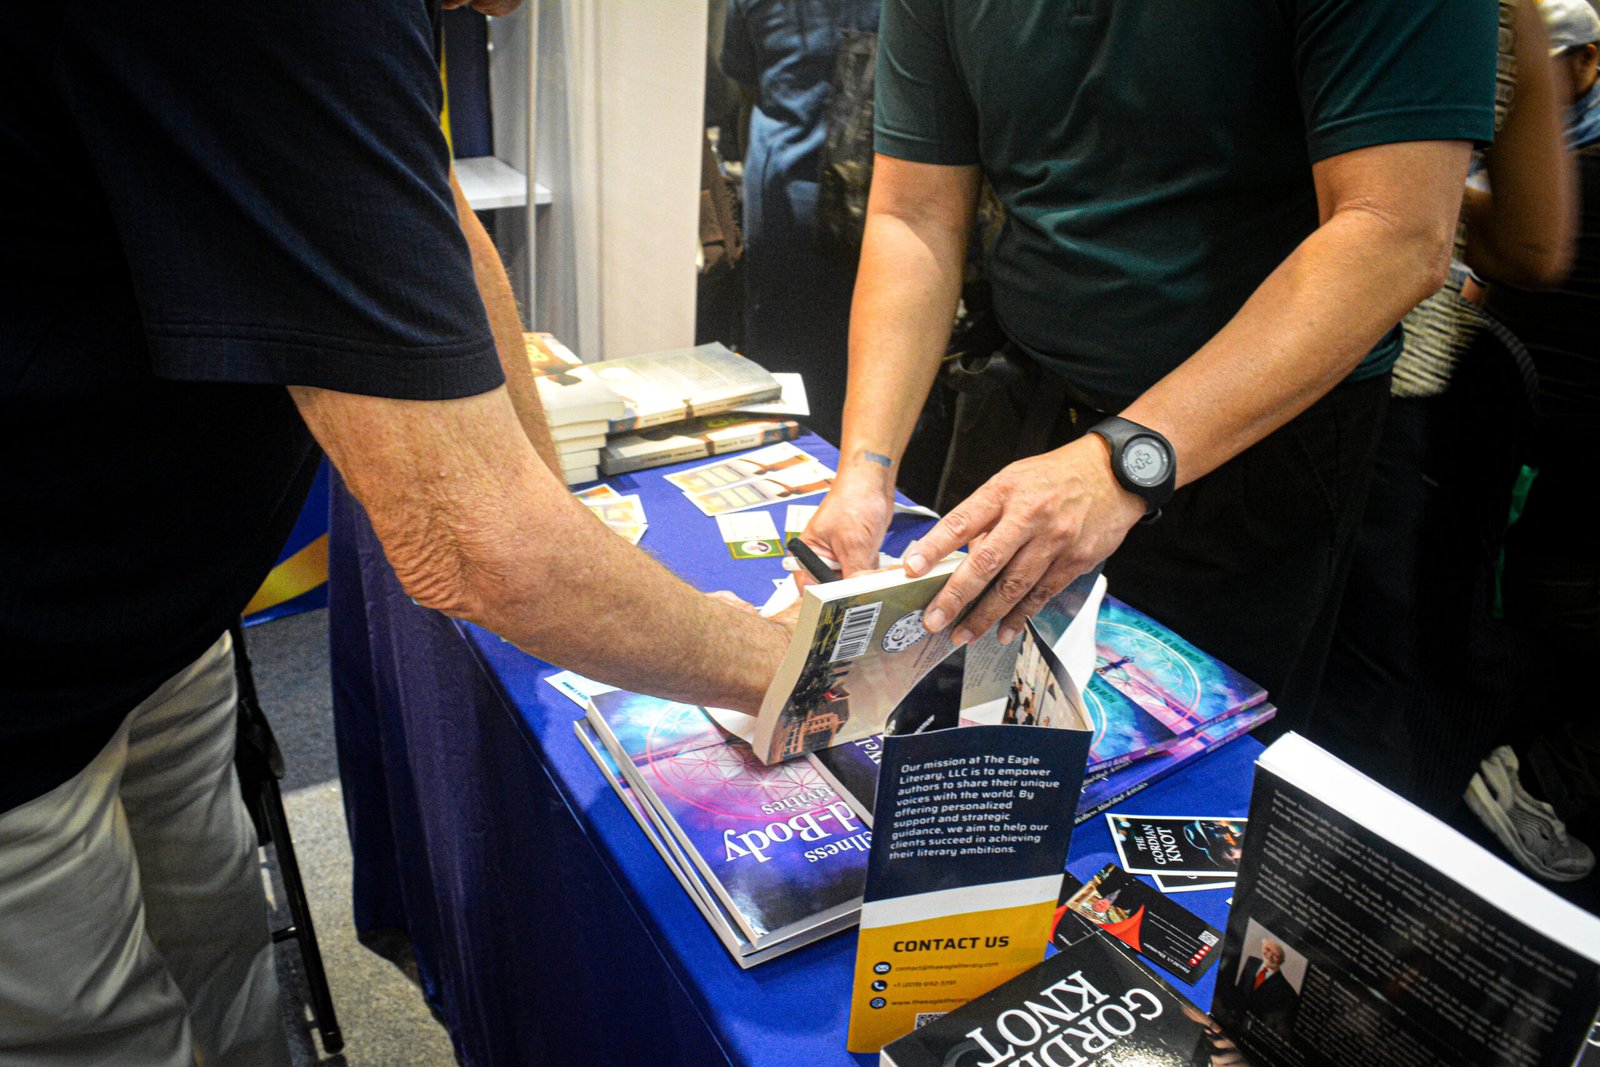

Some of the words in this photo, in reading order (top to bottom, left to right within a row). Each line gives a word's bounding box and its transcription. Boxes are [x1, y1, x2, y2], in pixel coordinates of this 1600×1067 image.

[901, 764, 920, 773] Our
[924, 758, 965, 769] mission
[984, 755, 1004, 763] The
[1008, 755, 1039, 765] Eagle
[948, 768, 968, 777] LLC
[898, 784, 939, 795] authors
[957, 780, 988, 788] share
[991, 779, 1017, 787] their
[1021, 780, 1060, 788] unique
[762, 786, 834, 815] tivities
[897, 796, 929, 806] voices
[933, 793, 957, 801] with
[961, 791, 978, 799] the
[982, 790, 1015, 798] world.
[1019, 790, 1034, 800] By
[895, 805, 938, 817] offering
[941, 801, 1012, 813] personalized
[894, 816, 935, 828] support
[962, 813, 1010, 822] strategic
[1003, 823, 1026, 832] help
[723, 802, 860, 863] d-Body
[804, 831, 872, 862] ellness
[890, 840, 925, 849] clients
[929, 836, 972, 845] succeed
[975, 835, 986, 843] in
[988, 835, 1041, 843] achieving
[1134, 836, 1147, 851] THE
[1142, 823, 1167, 865] GORDIAN
[1157, 826, 1184, 862] KNOT
[889, 851, 914, 860] their
[917, 848, 957, 857] literary
[960, 846, 1016, 855] ambitions.
[893, 937, 980, 952] CONTACT
[985, 936, 1009, 948] US
[966, 970, 1110, 1067] KNOT
